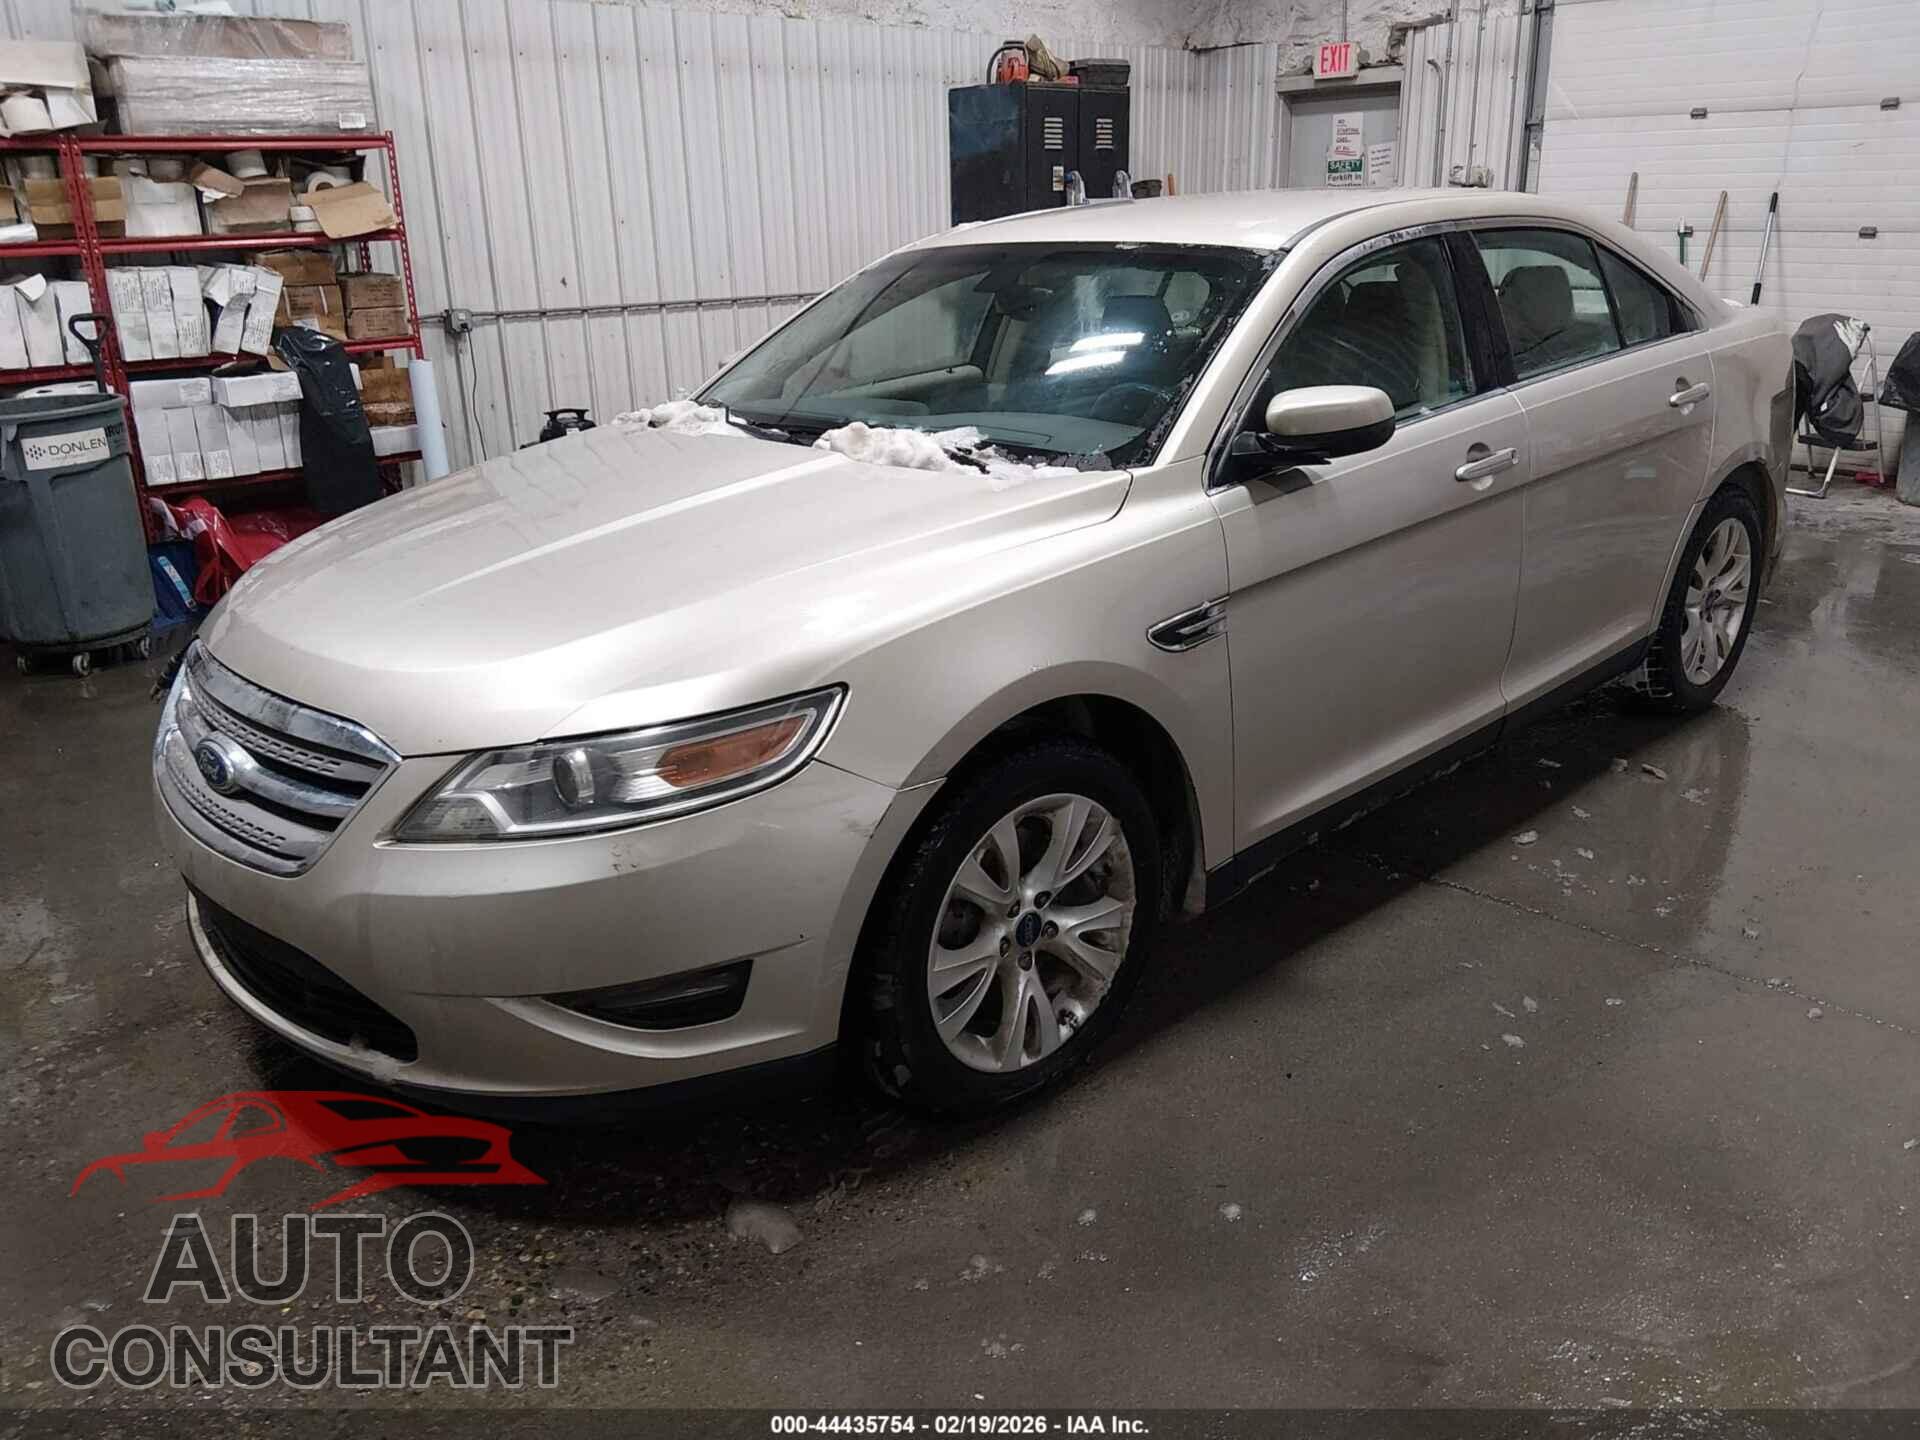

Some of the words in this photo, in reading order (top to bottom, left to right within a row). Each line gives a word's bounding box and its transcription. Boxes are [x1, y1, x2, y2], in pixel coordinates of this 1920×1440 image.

[1321, 44, 1350, 73] EXIT
[1329, 160, 1361, 170] SAFETY
[49, 437, 107, 456] DONLEN
